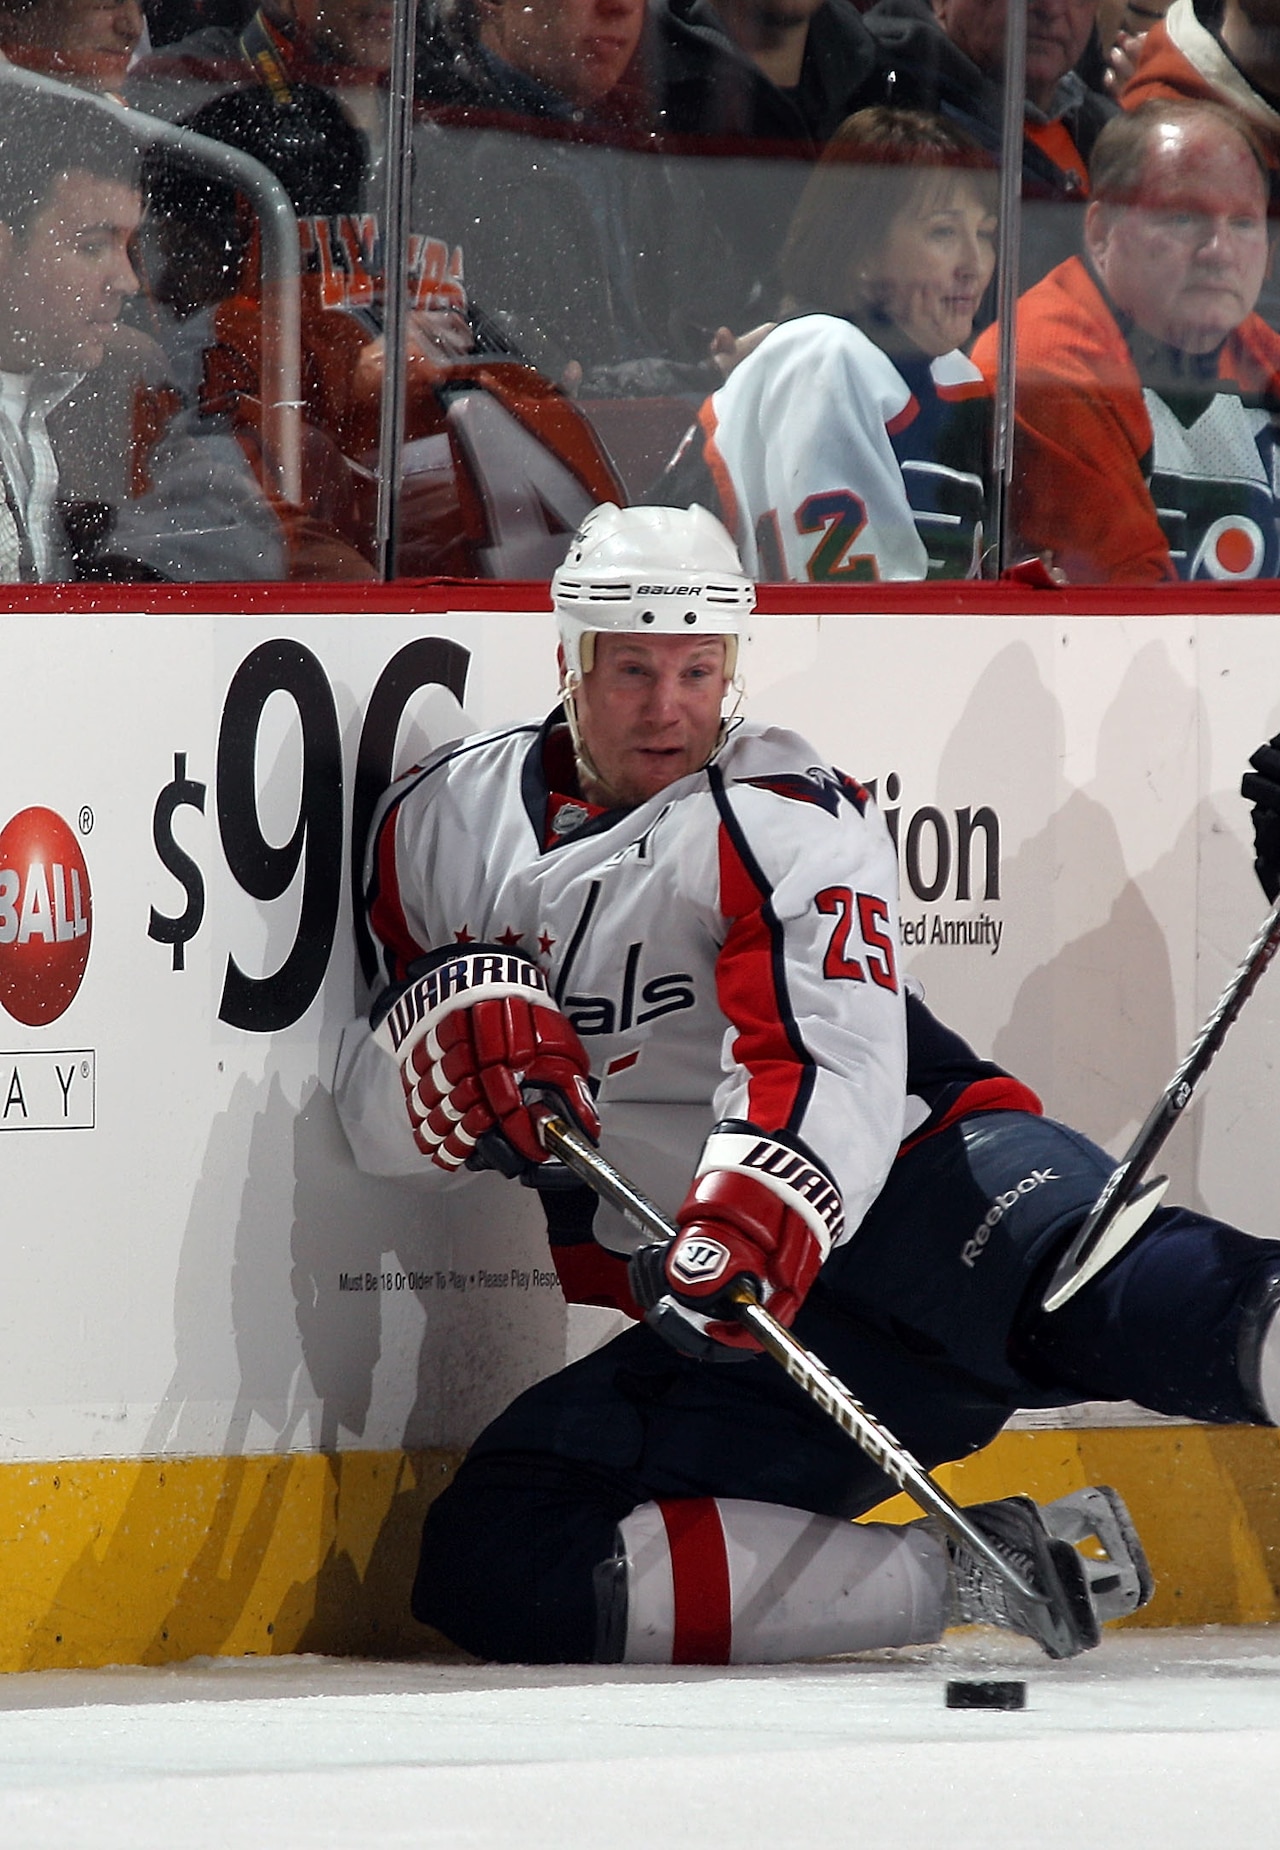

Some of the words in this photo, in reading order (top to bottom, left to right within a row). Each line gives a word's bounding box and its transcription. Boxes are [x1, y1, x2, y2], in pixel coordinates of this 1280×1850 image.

[637, 585, 703, 597] BAUER
[814, 885, 898, 996] 25
[931, 913, 1003, 955] Annuity
[962, 1167, 1061, 1267] Reebok
[339, 1273, 363, 1291] Must
[365, 1273, 378, 1291] Be
[381, 1273, 393, 1291] 18
[395, 1273, 406, 1290] Or
[408, 1272, 433, 1291] Older
[435, 1272, 447, 1290] To
[478, 1270, 509, 1289] Please
[511, 1269, 530, 1291] Play
